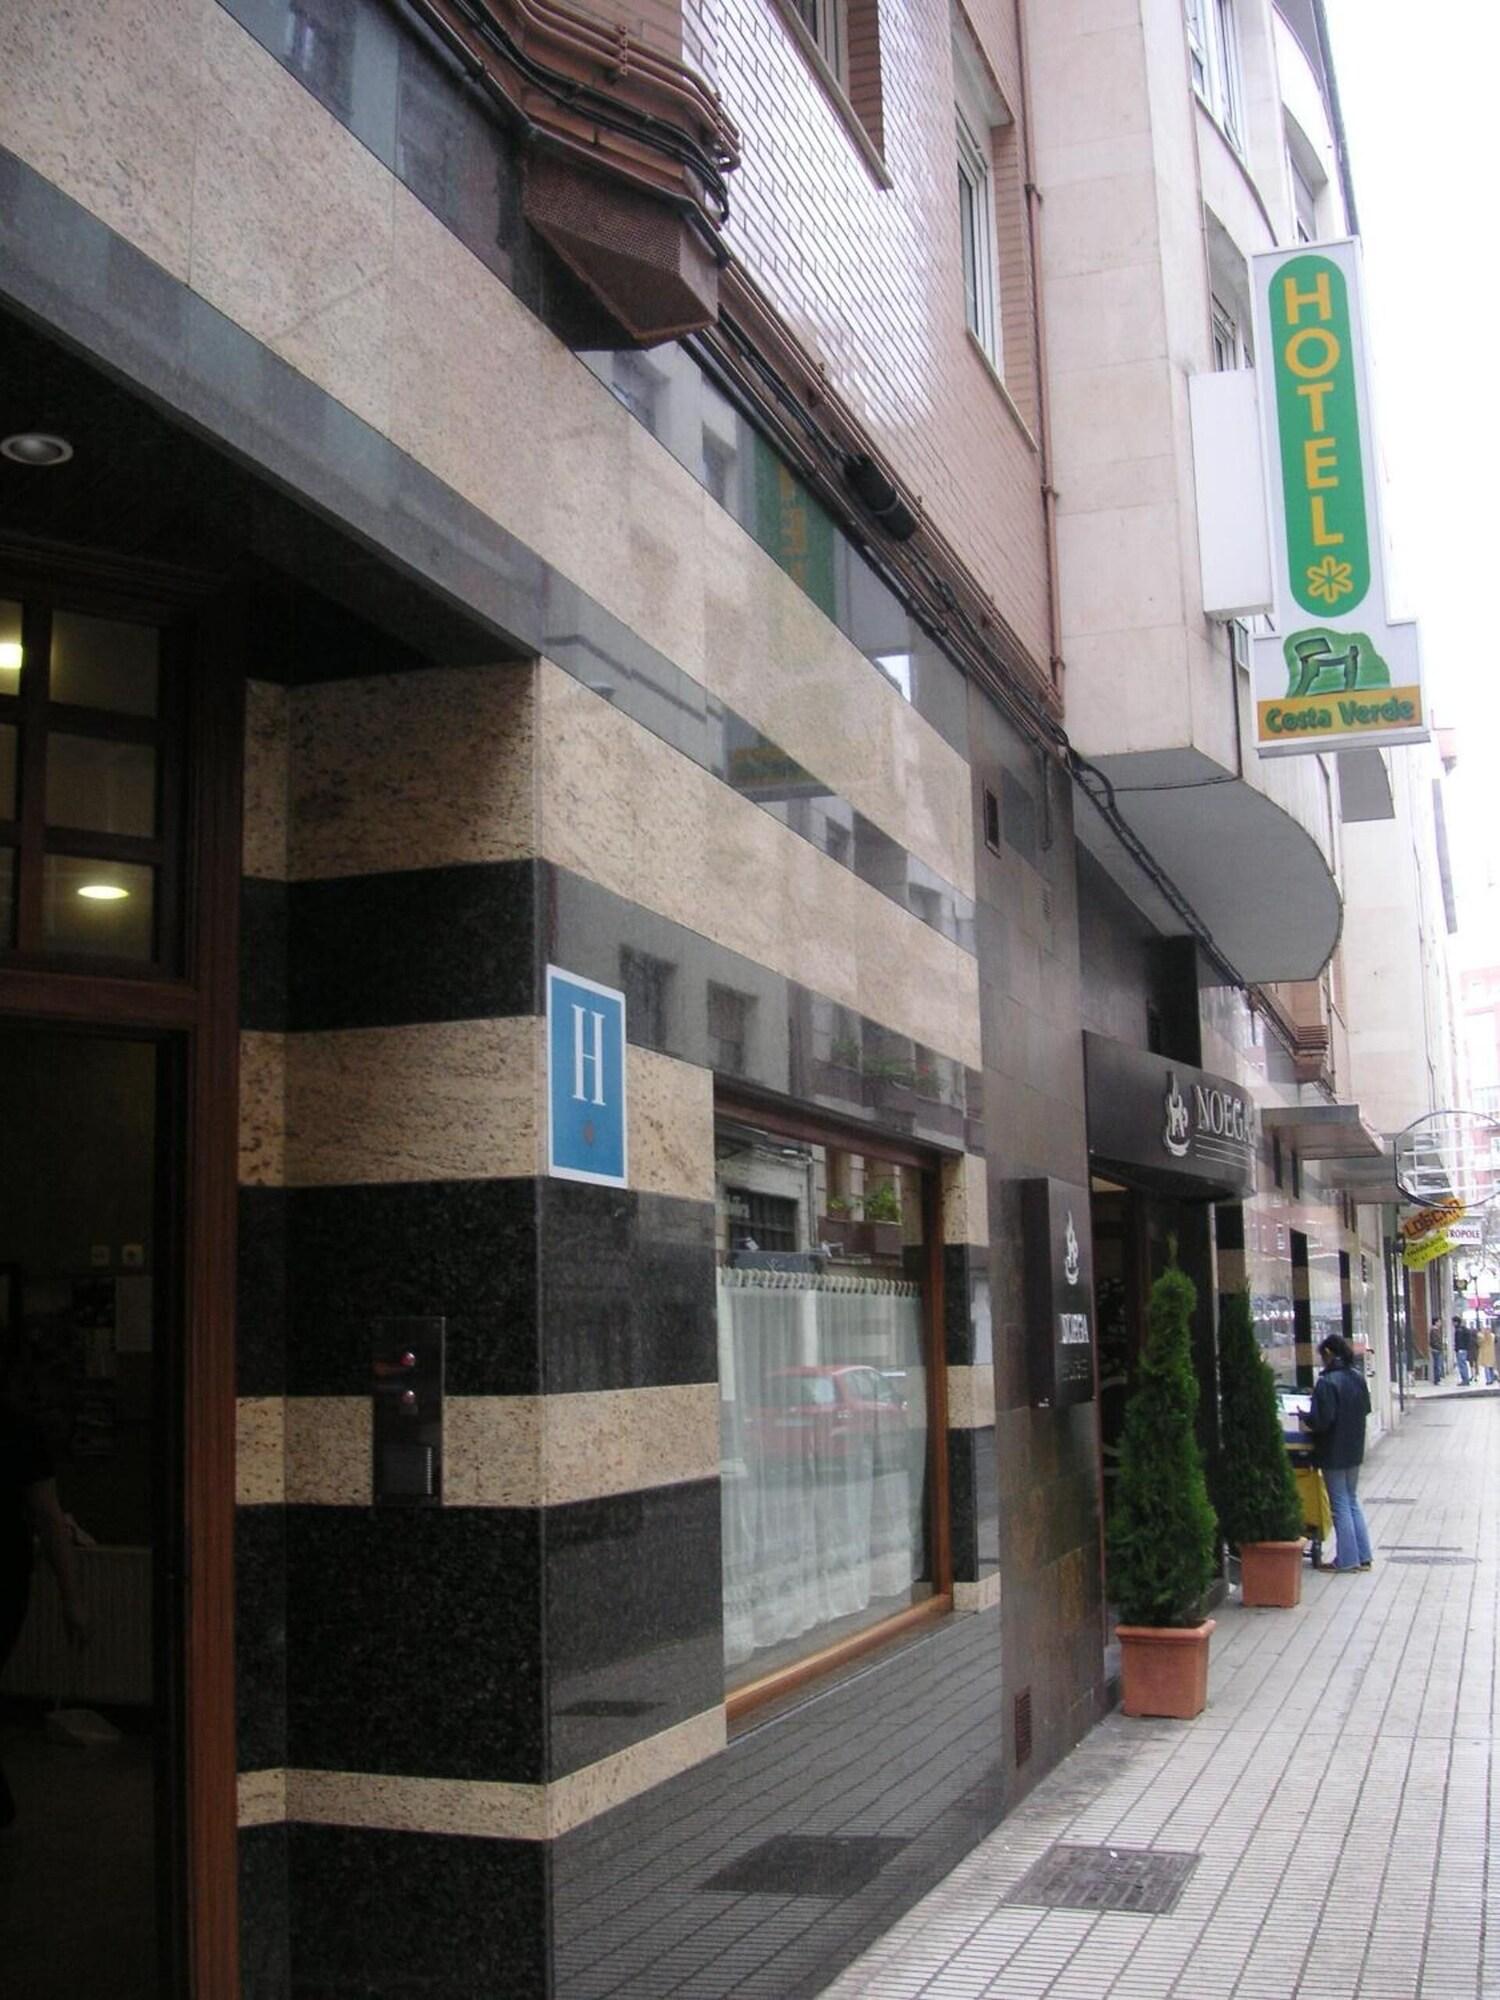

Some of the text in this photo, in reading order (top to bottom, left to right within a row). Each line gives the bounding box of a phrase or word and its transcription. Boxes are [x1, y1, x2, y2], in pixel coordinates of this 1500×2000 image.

[1284, 272, 1343, 547] HOTEL
[1265, 696, 1415, 734] Costa Verde
[572, 1003, 607, 1106] H
[1194, 1085, 1258, 1149] NOEGA
